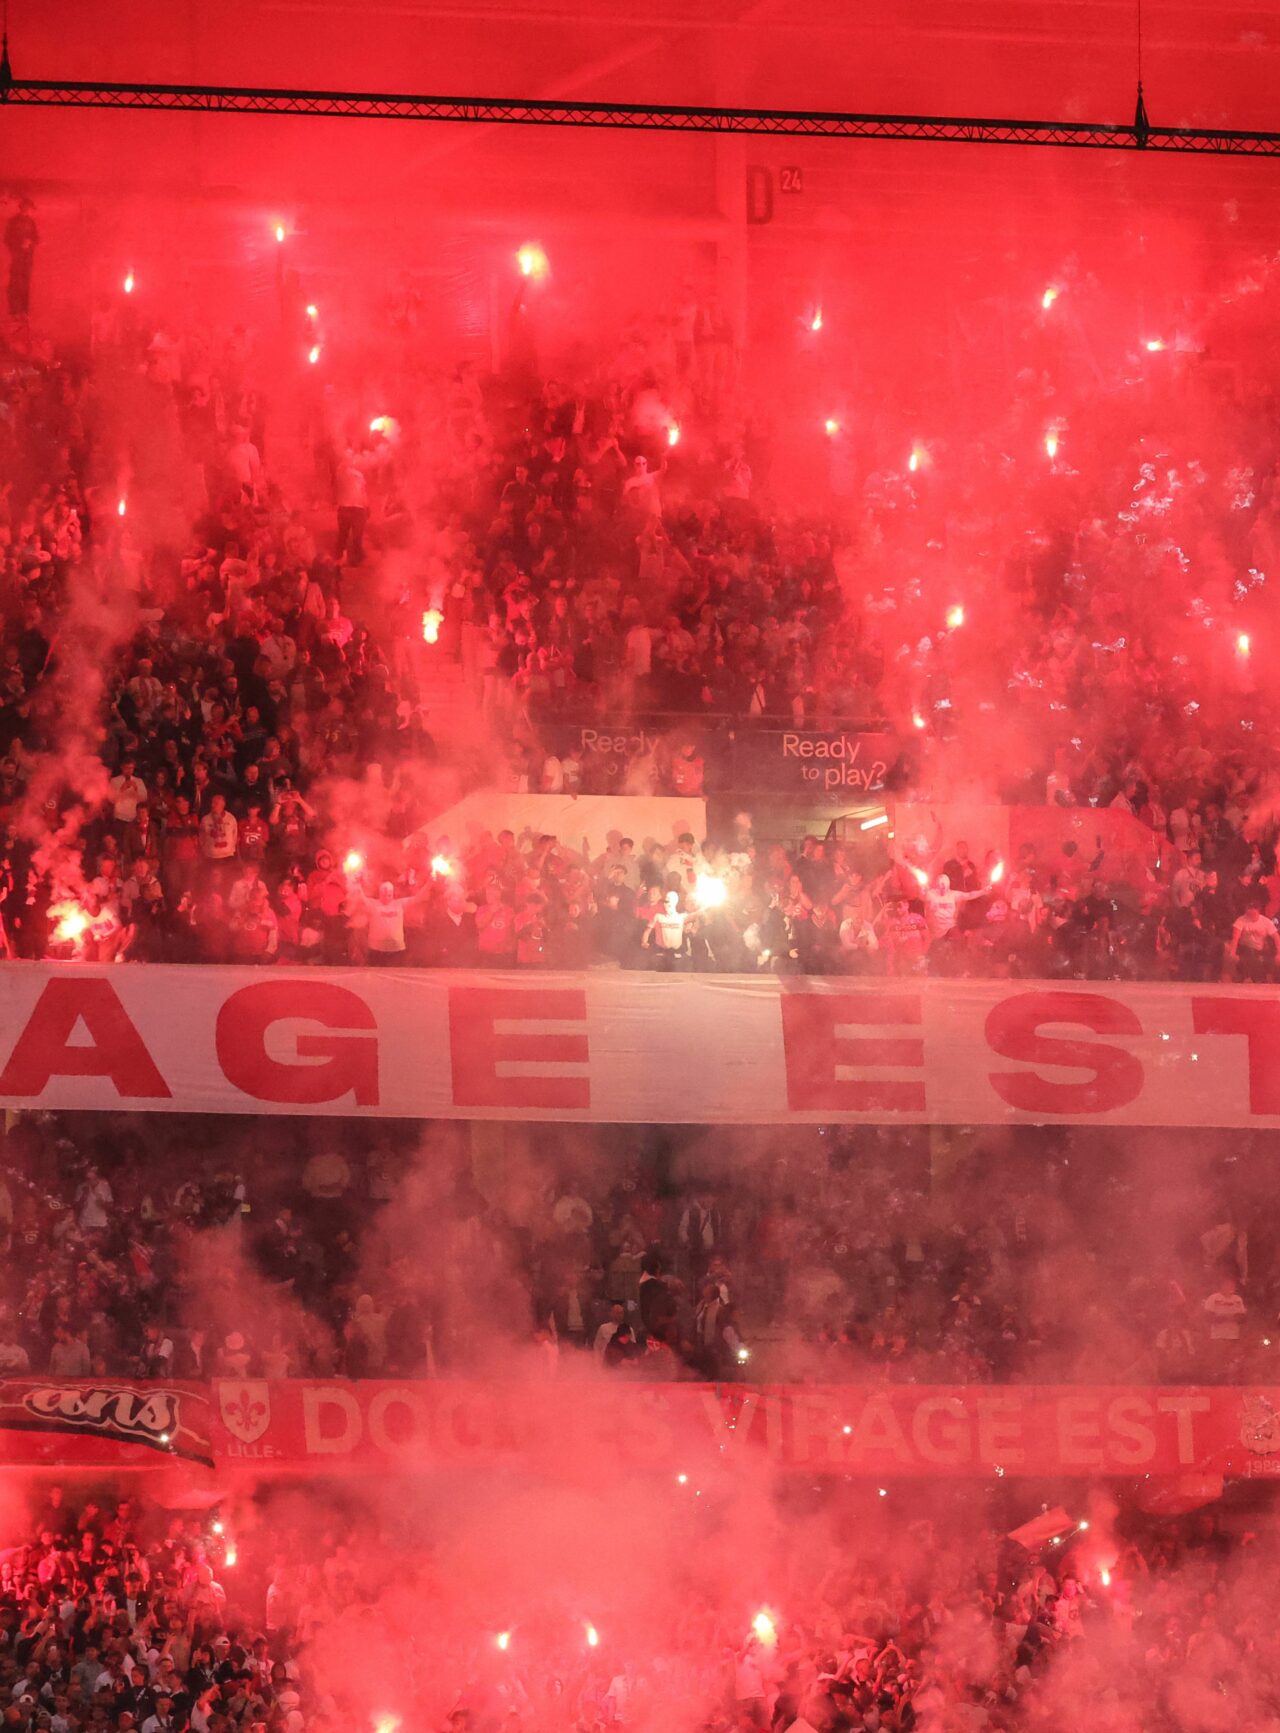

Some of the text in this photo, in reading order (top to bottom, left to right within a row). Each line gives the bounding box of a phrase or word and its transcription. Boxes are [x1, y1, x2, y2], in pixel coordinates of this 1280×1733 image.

[746, 165, 801, 225] D 24
[783, 734, 861, 763] Ready
[802, 761, 887, 791] to play?
[302, 1386, 1211, 1465] DOGS VIRAGE EST
[227, 1443, 273, 1458] LILLE
